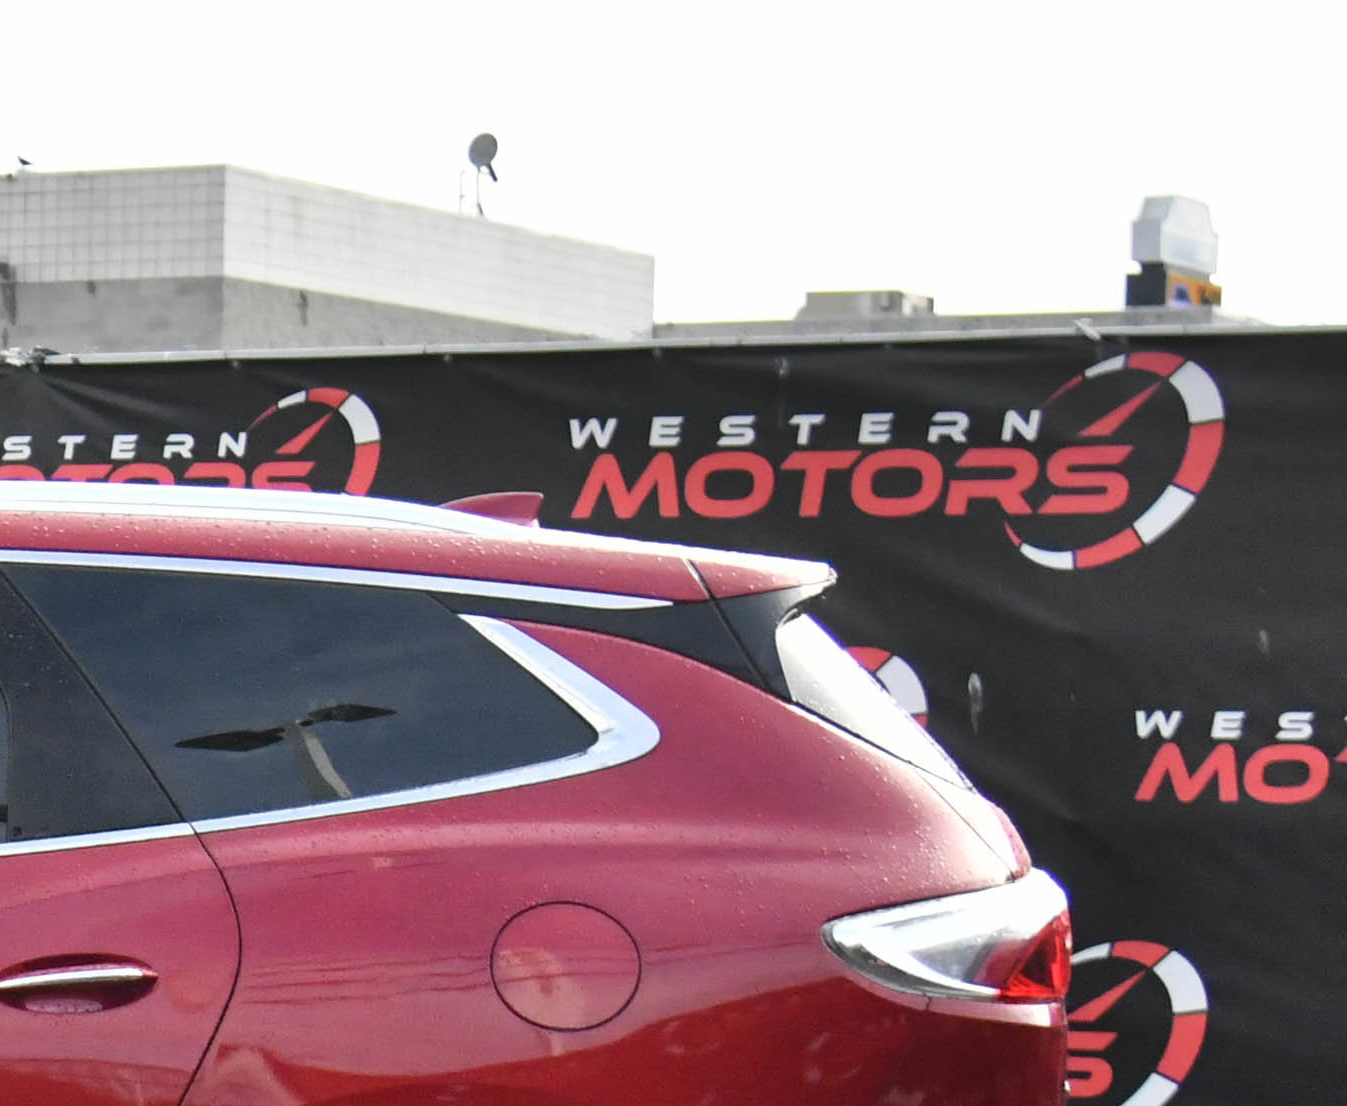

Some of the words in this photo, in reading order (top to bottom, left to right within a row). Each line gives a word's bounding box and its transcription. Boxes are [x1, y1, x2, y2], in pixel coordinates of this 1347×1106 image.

[569, 409, 1042, 449] WESTERN
[570, 444, 1134, 520] MOTORS
[1135, 710, 1347, 741] WES
[1134, 741, 1347, 805] MO
